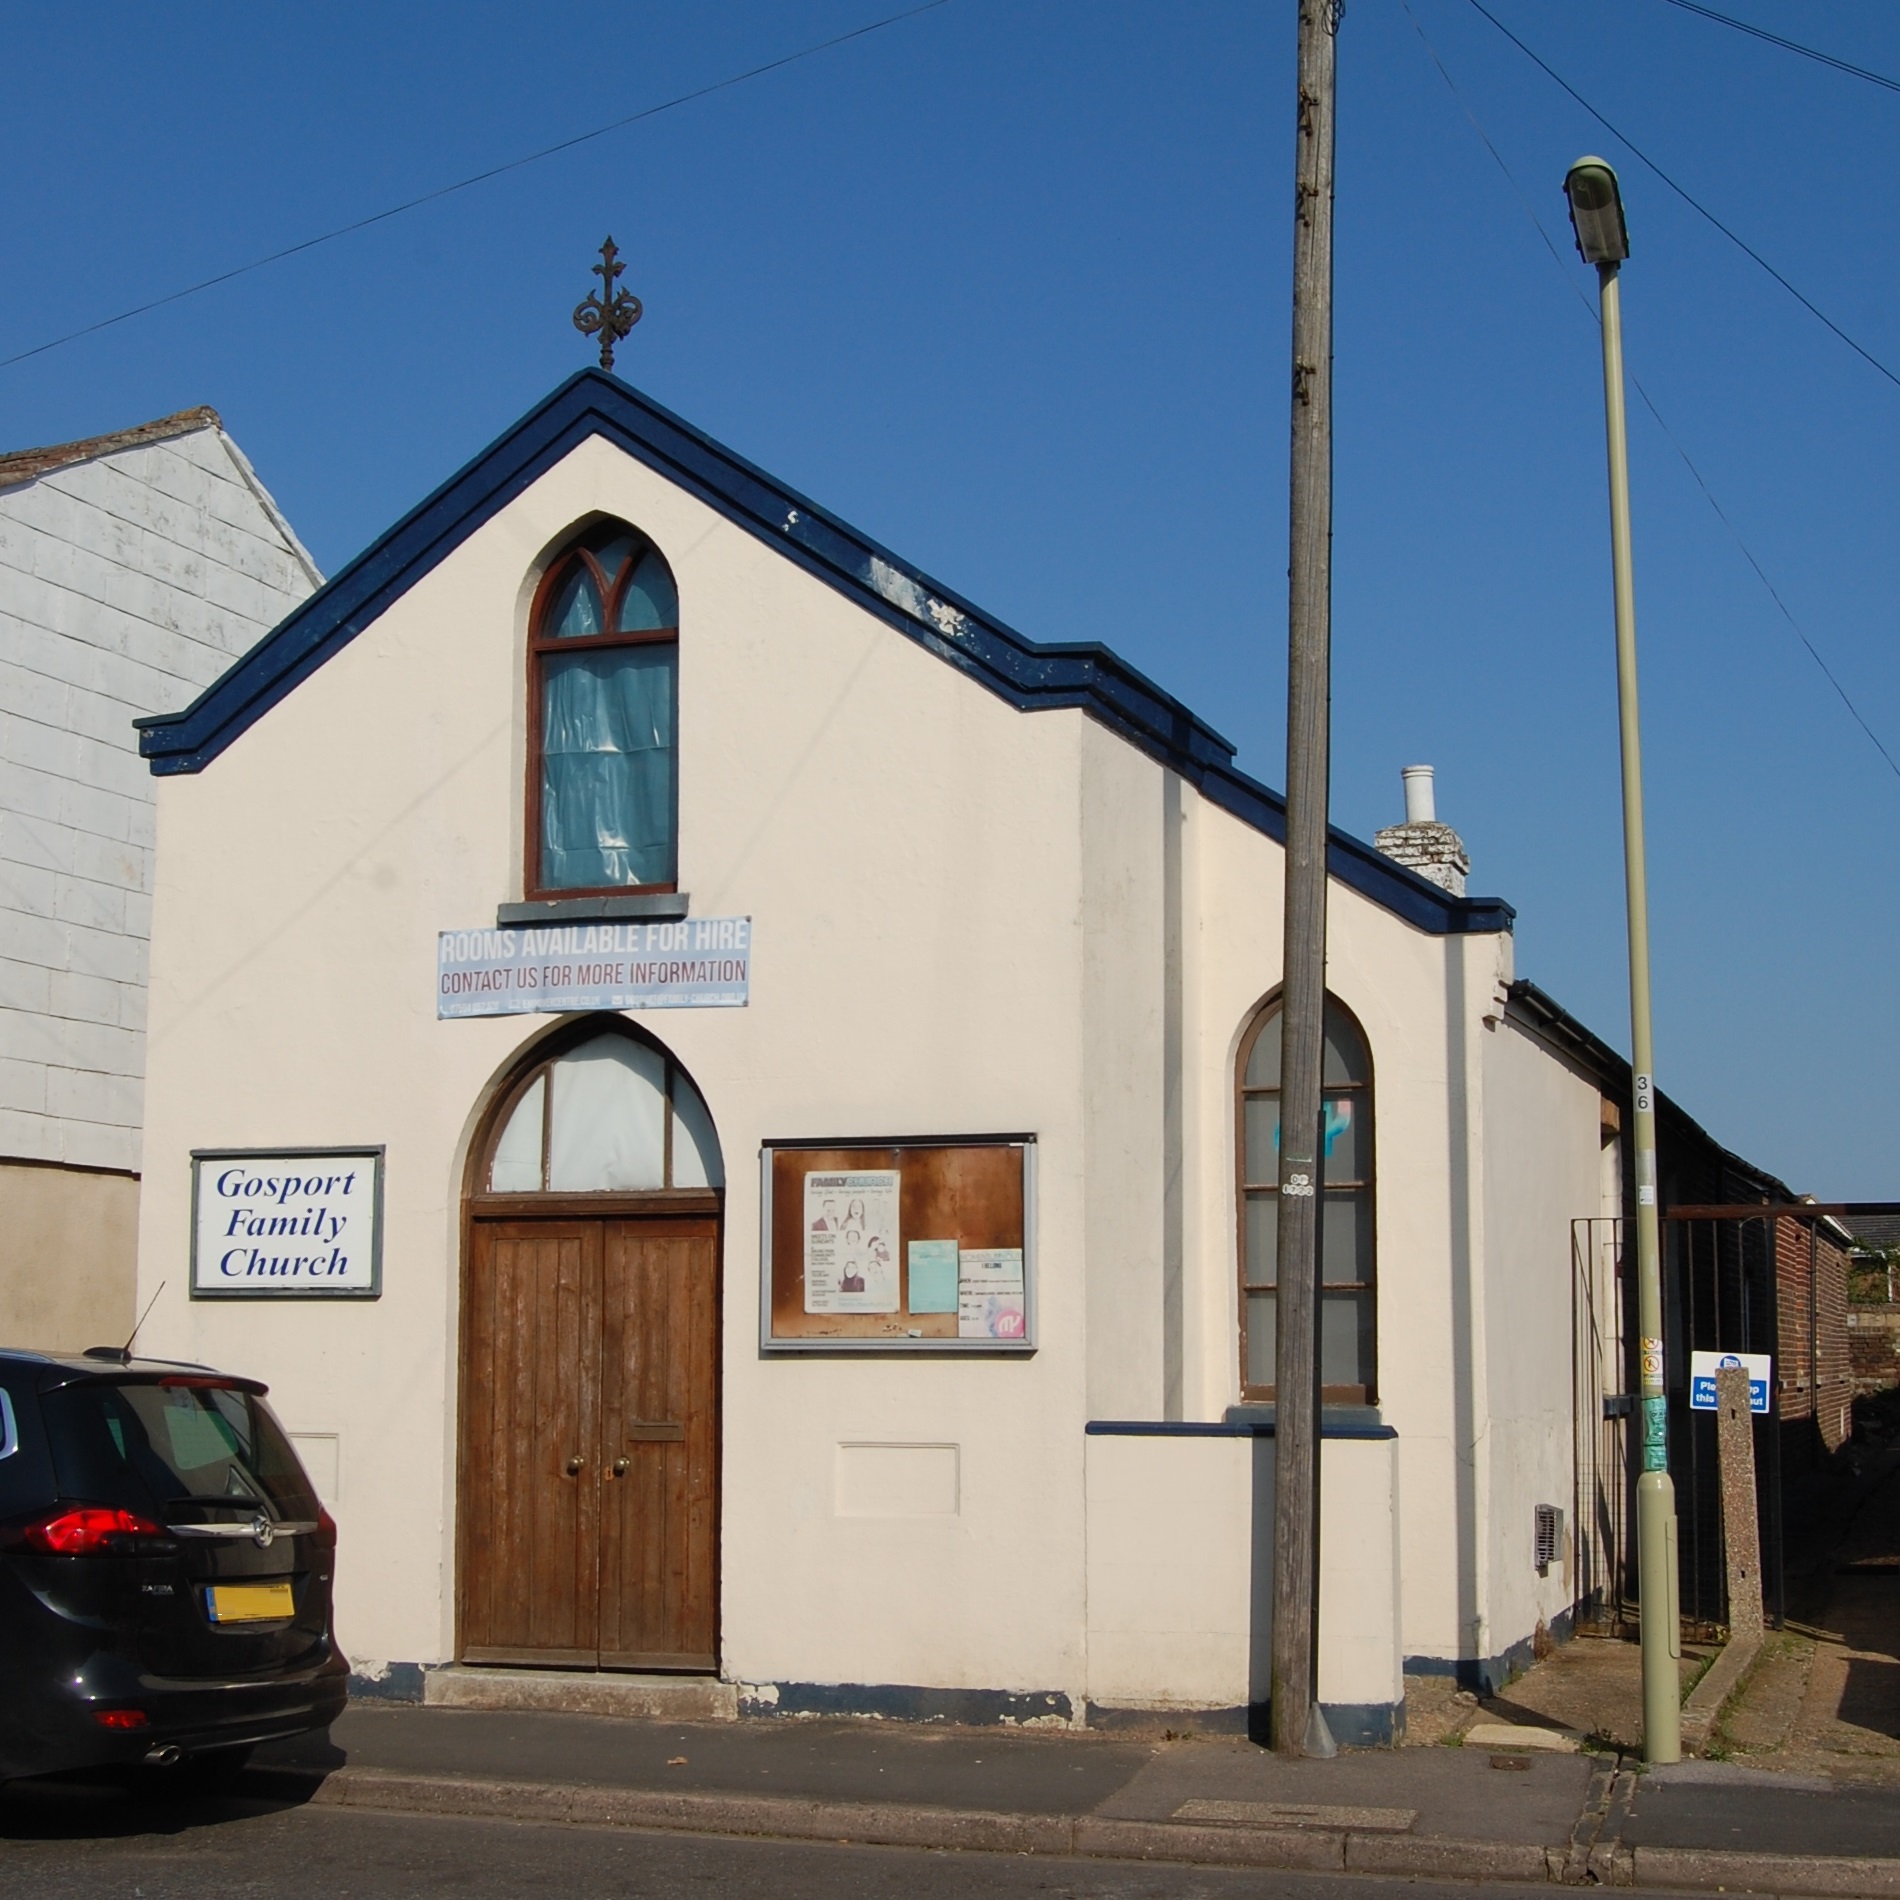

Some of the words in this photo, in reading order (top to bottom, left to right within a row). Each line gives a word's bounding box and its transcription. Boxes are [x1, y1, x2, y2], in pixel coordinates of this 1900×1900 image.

[441, 930, 516, 963] ROOMS
[522, 924, 639, 957] AVAILABLE
[647, 922, 690, 952] FOR
[696, 919, 747, 950] HIRE
[441, 969, 513, 995] CONTACT
[517, 967, 538, 989] US
[543, 965, 572, 988] FOR
[576, 963, 625, 985] MORE
[630, 959, 747, 984] INFORMATION
[216, 1168, 357, 1205] Gosport
[222, 1207, 348, 1244] Family
[220, 1247, 349, 1277] Church
[1695, 1393, 1715, 1403] this
[1700, 1381, 1717, 1391] Ple
